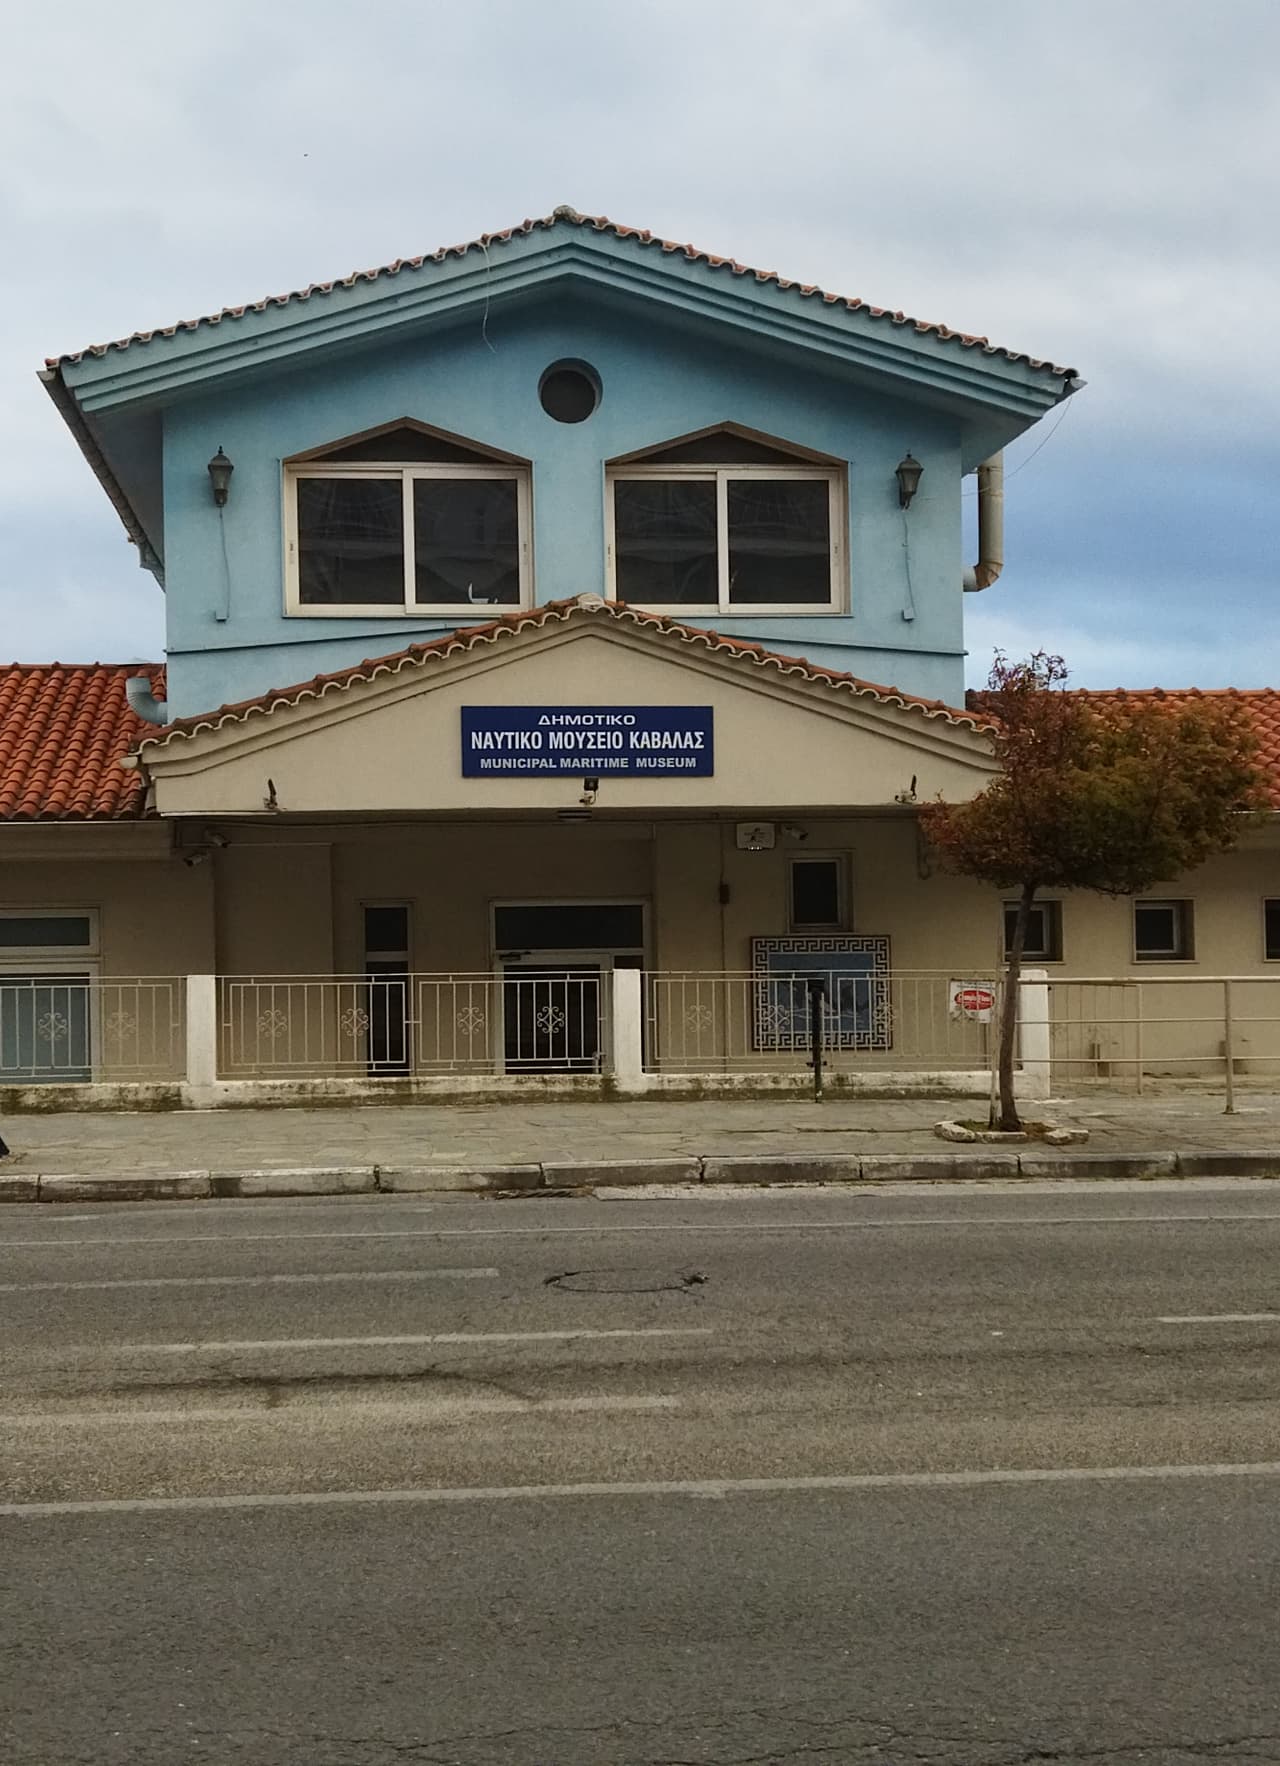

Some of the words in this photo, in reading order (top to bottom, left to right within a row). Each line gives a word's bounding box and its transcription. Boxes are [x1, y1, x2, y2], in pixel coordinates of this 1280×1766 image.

[538, 714, 636, 726] ΔΗΜΟΤΙΚΟ
[471, 731, 542, 750] ΝΑΥΤΙΚΟ
[549, 731, 623, 750] ΜΟΥΣΕΙΟ
[629, 731, 705, 750] ΚΑΒΑΛΑΣ
[480, 758, 557, 769] MUNICIPAL
[560, 758, 629, 769] MARITIME
[636, 758, 697, 768] MUSEUM
